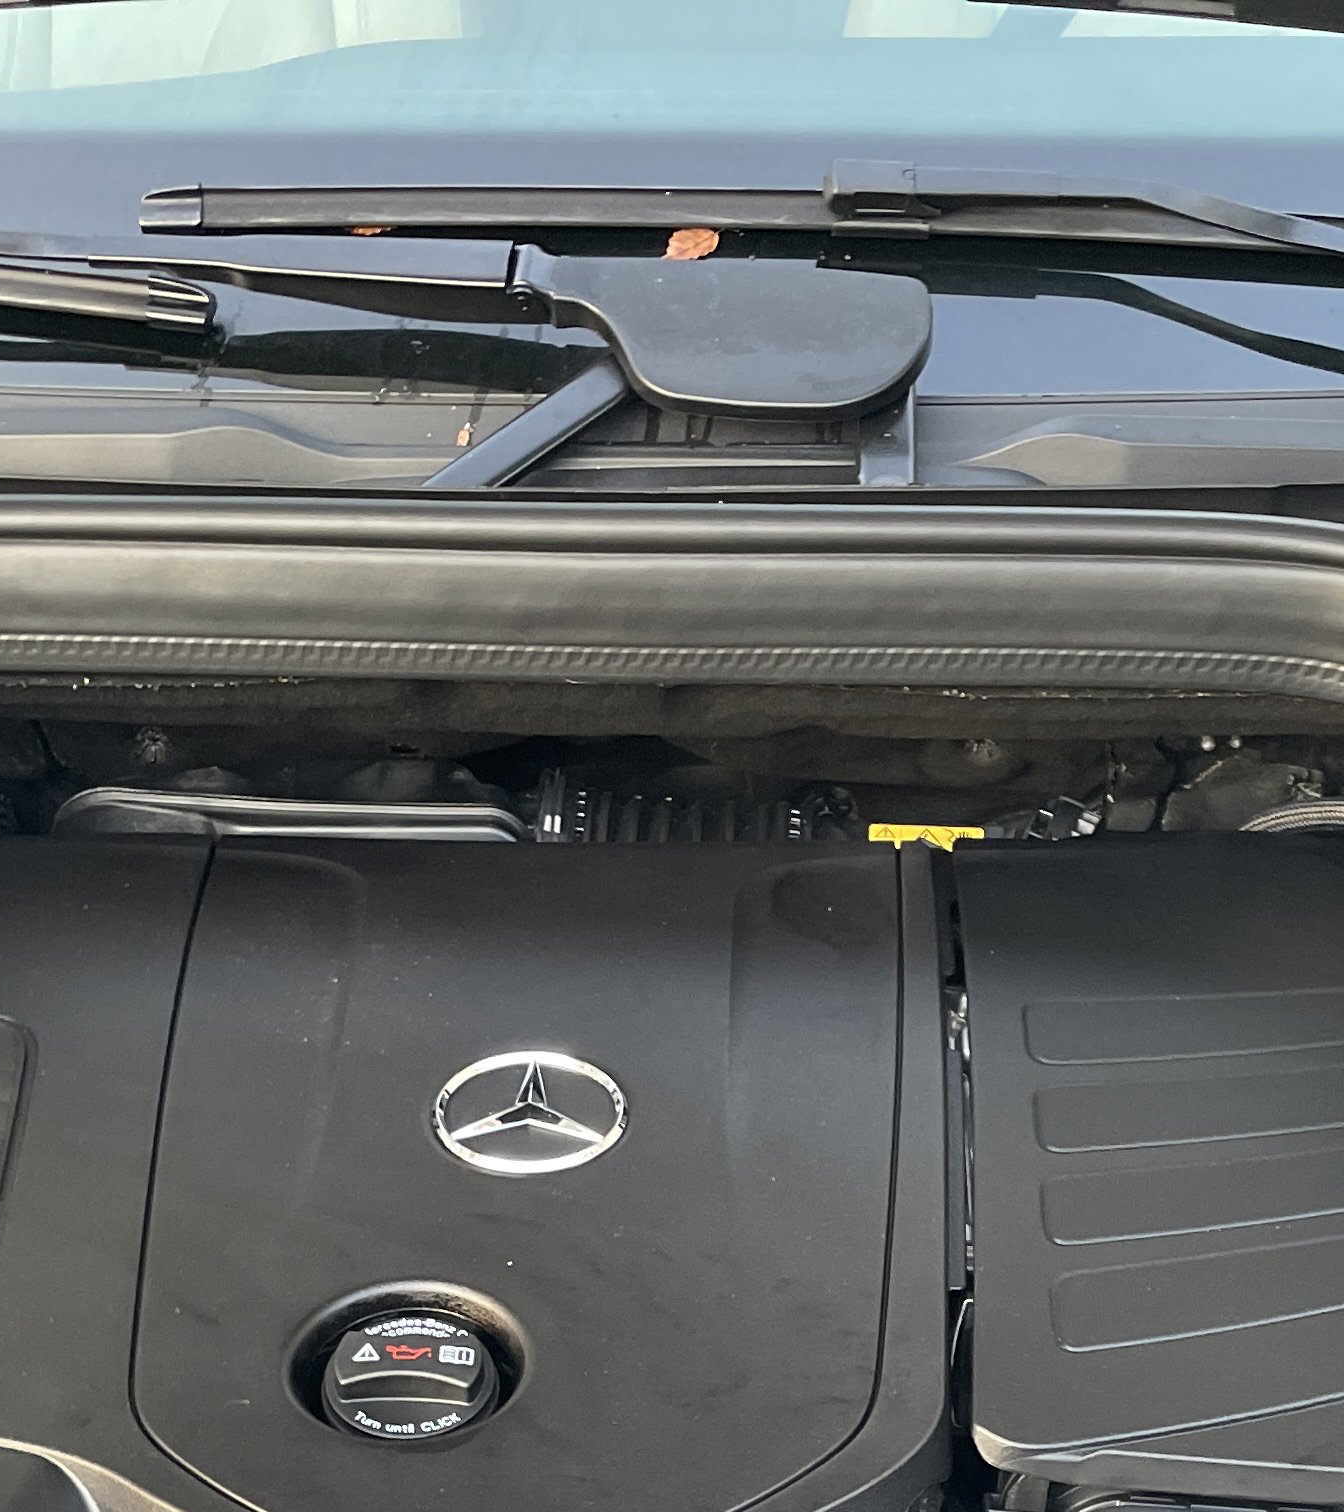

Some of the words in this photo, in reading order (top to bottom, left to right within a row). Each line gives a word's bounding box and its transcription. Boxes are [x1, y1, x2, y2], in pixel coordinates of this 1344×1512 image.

[354, 1411, 382, 1430] Turn
[385, 1423, 415, 1433] until
[420, 1412, 462, 1432] CLICK
